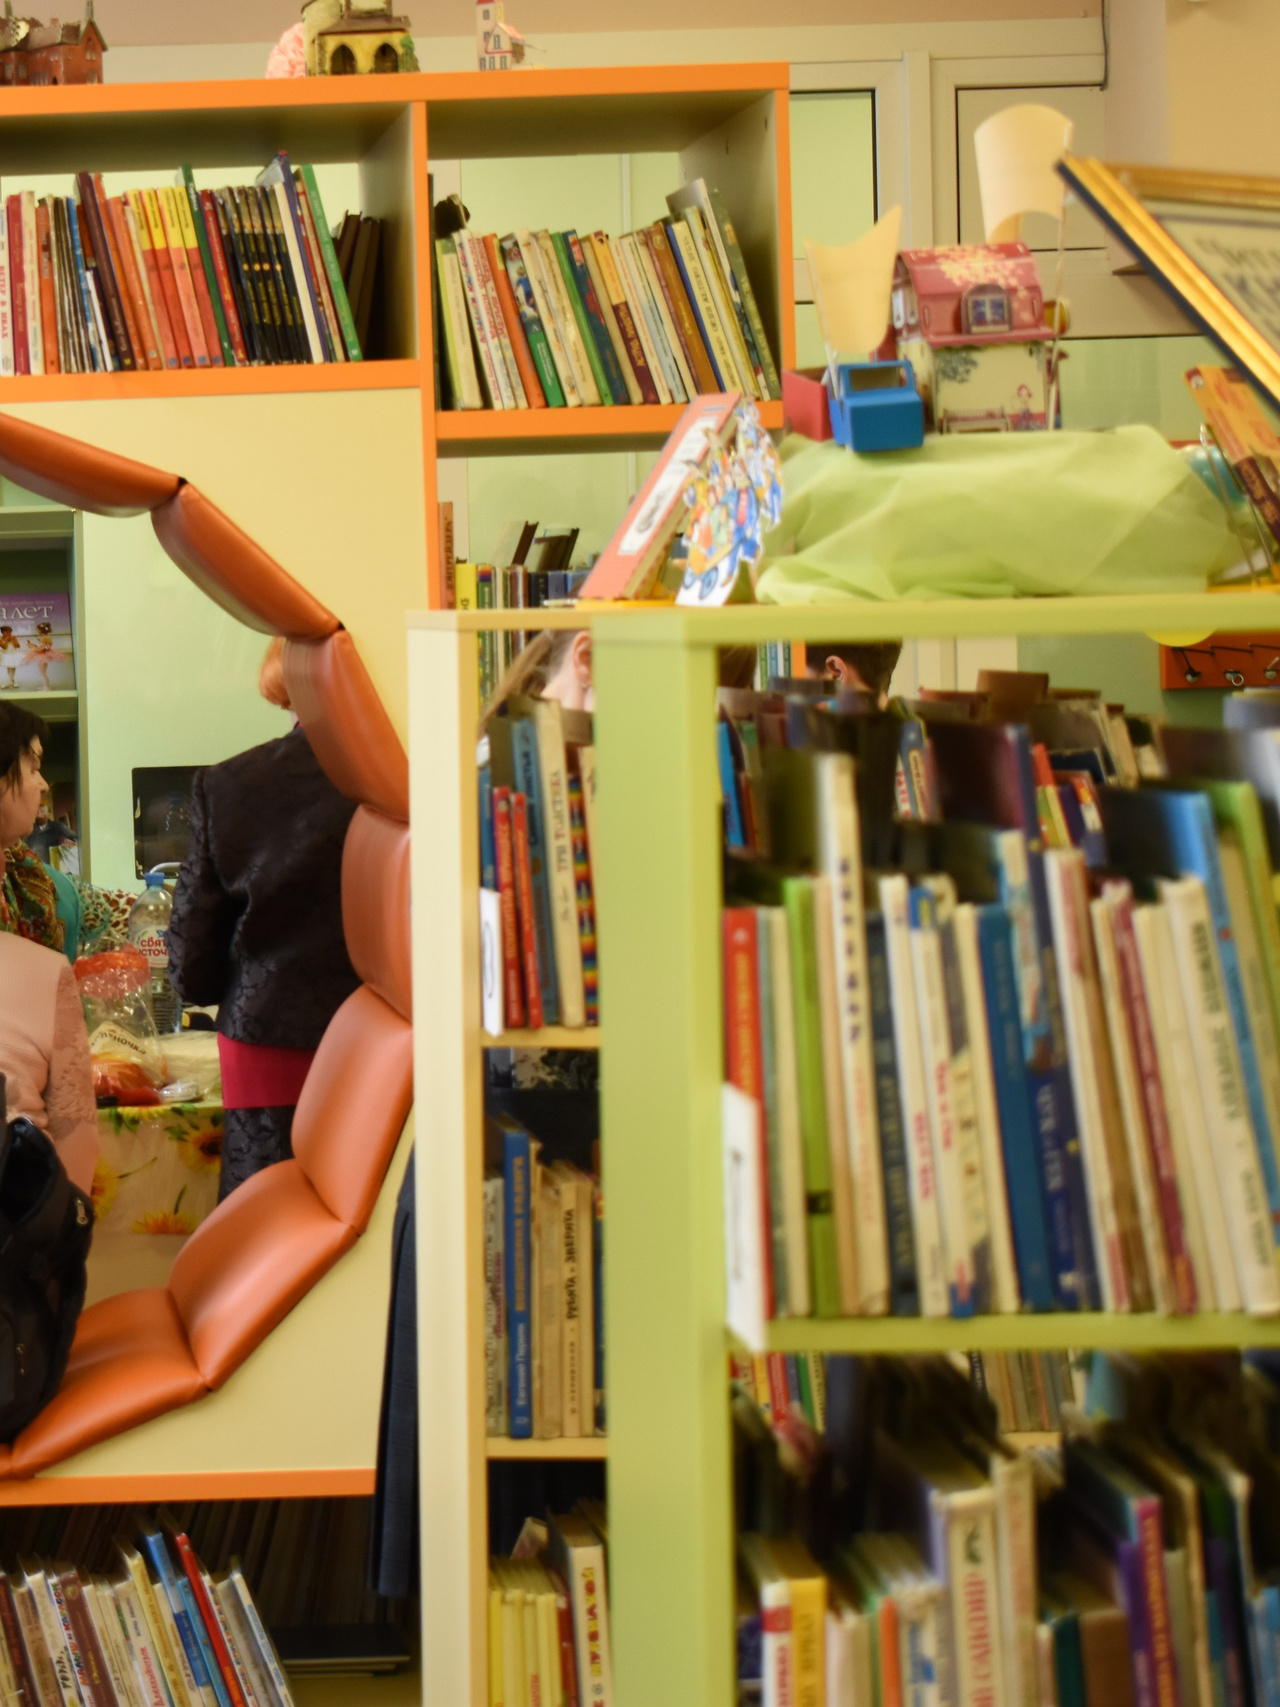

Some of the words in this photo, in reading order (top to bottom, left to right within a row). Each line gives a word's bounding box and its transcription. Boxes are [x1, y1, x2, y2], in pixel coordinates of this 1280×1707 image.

[0, 310, 9, 339] ИВАХ
[138, 948, 169, 957] сточ
[140, 936, 166, 948] свят
[564, 1207, 575, 1262] ЗВЕРЯТА
[514, 1322, 526, 1360] Пермяк
[515, 1362, 526, 1405] Евгений
[49, 1582, 72, 1632] КАРЛСОН
[68, 1641, 89, 1687] МАЛЫШ
